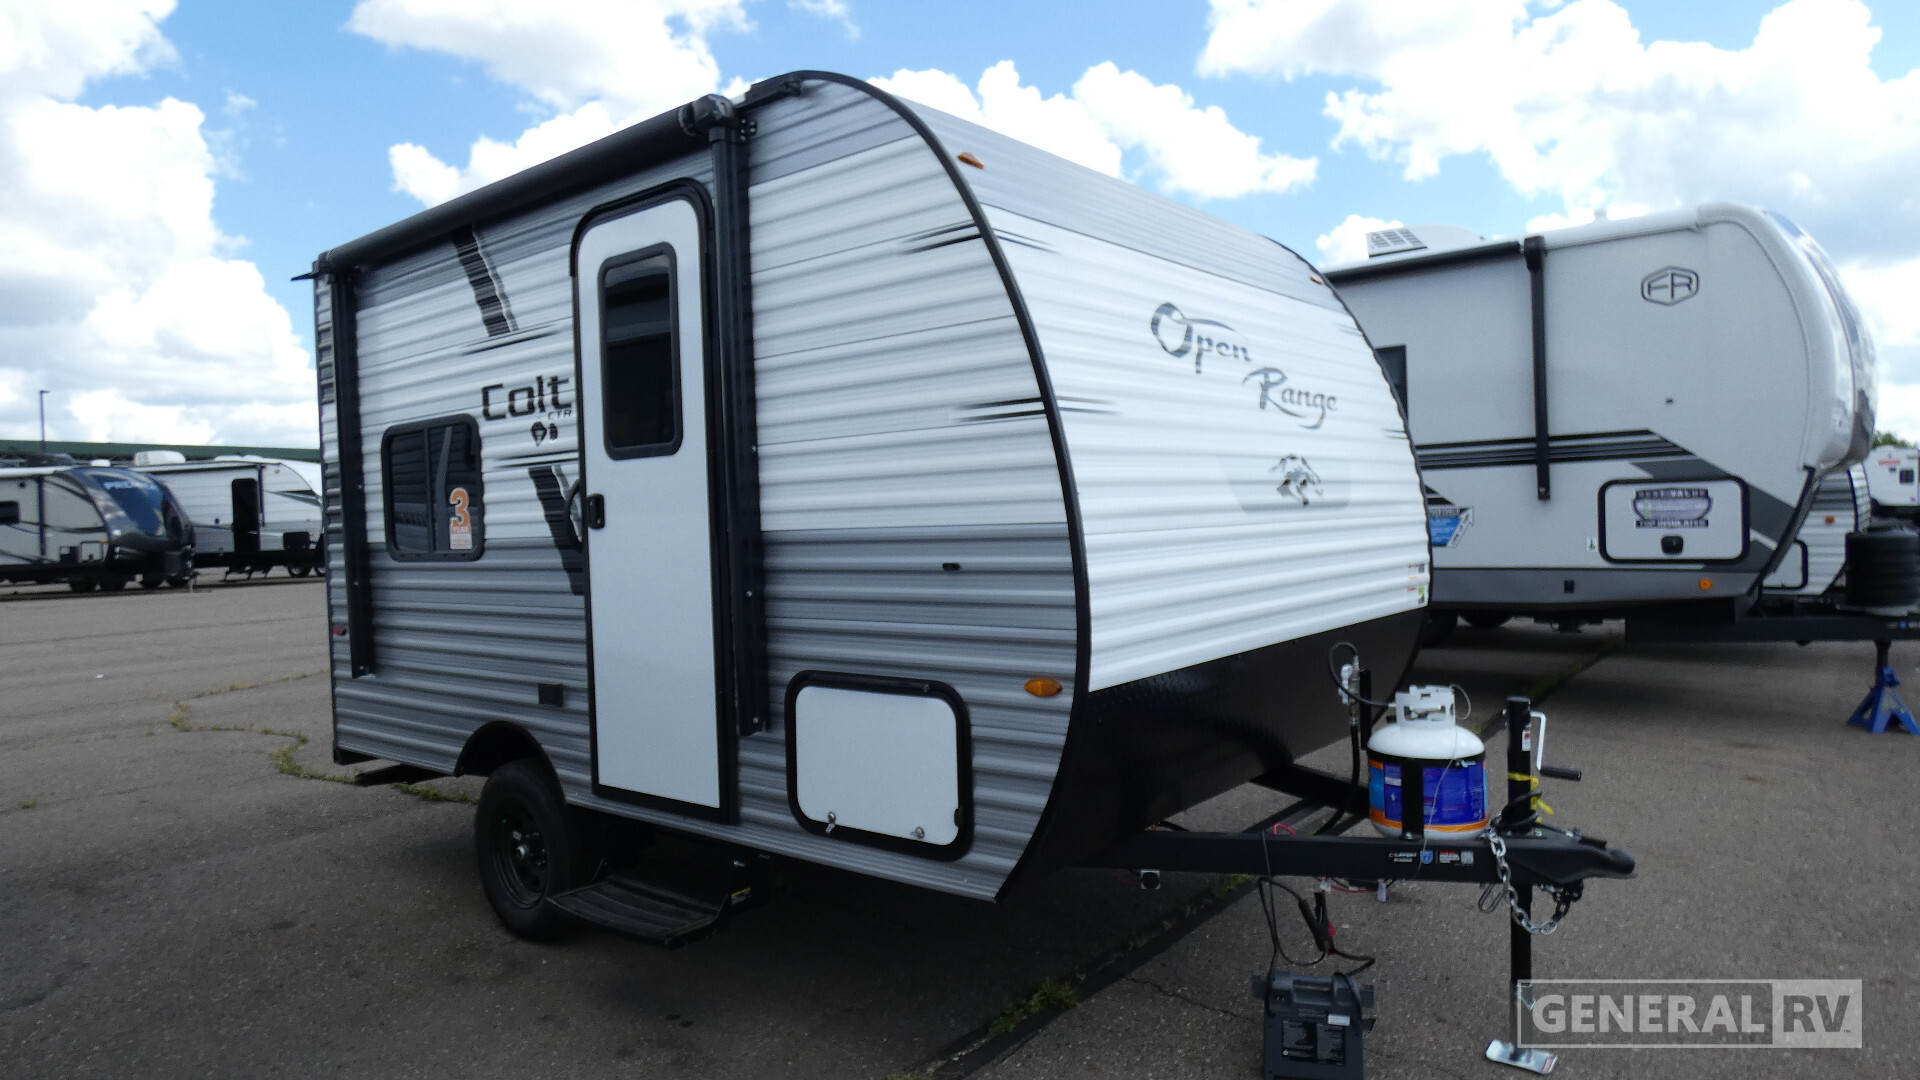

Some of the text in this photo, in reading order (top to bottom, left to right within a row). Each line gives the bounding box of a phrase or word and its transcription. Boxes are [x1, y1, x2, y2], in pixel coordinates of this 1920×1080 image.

[1150, 302, 1252, 374] Open
[481, 375, 572, 421] Colt
[1242, 367, 1337, 429] Range
[450, 487, 470, 527] 3
